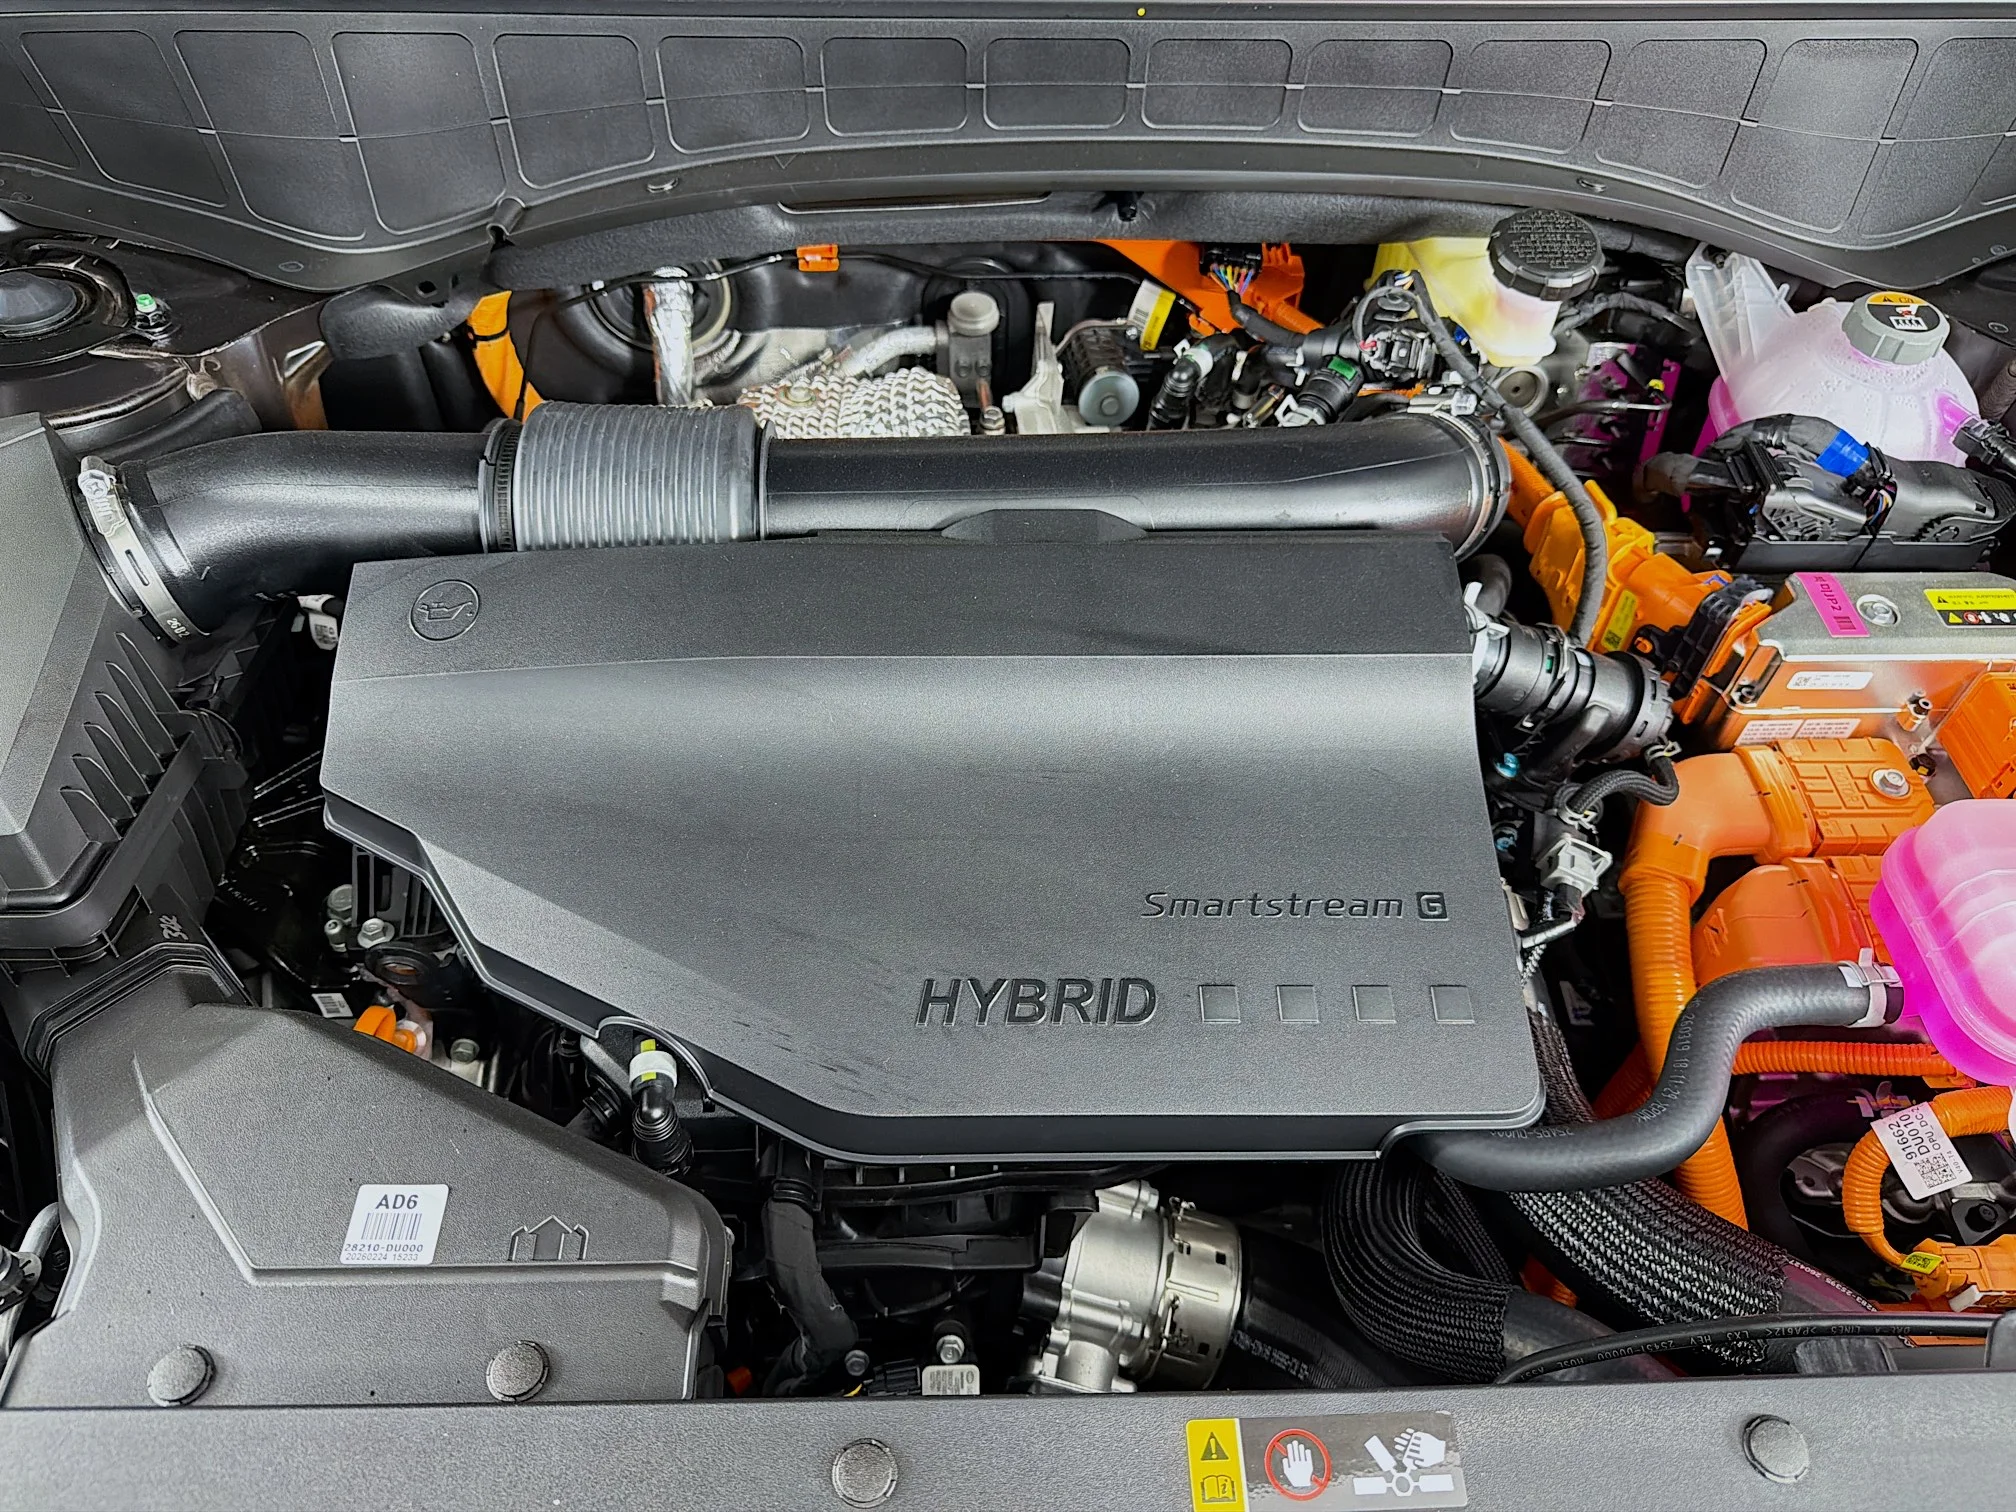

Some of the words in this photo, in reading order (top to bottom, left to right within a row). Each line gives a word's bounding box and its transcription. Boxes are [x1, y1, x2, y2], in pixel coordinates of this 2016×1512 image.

[1141, 892, 1403, 918] Smartstream
[1417, 892, 1446, 918] G
[916, 978, 1158, 1026] HYBRID
[1888, 1121, 1917, 1161] 91662
[1899, 1113, 1931, 1156] DU010
[375, 1194, 419, 1210] AD6
[344, 1243, 424, 1252] 28210-DU000
[1690, 1334, 1711, 1345] HEV
